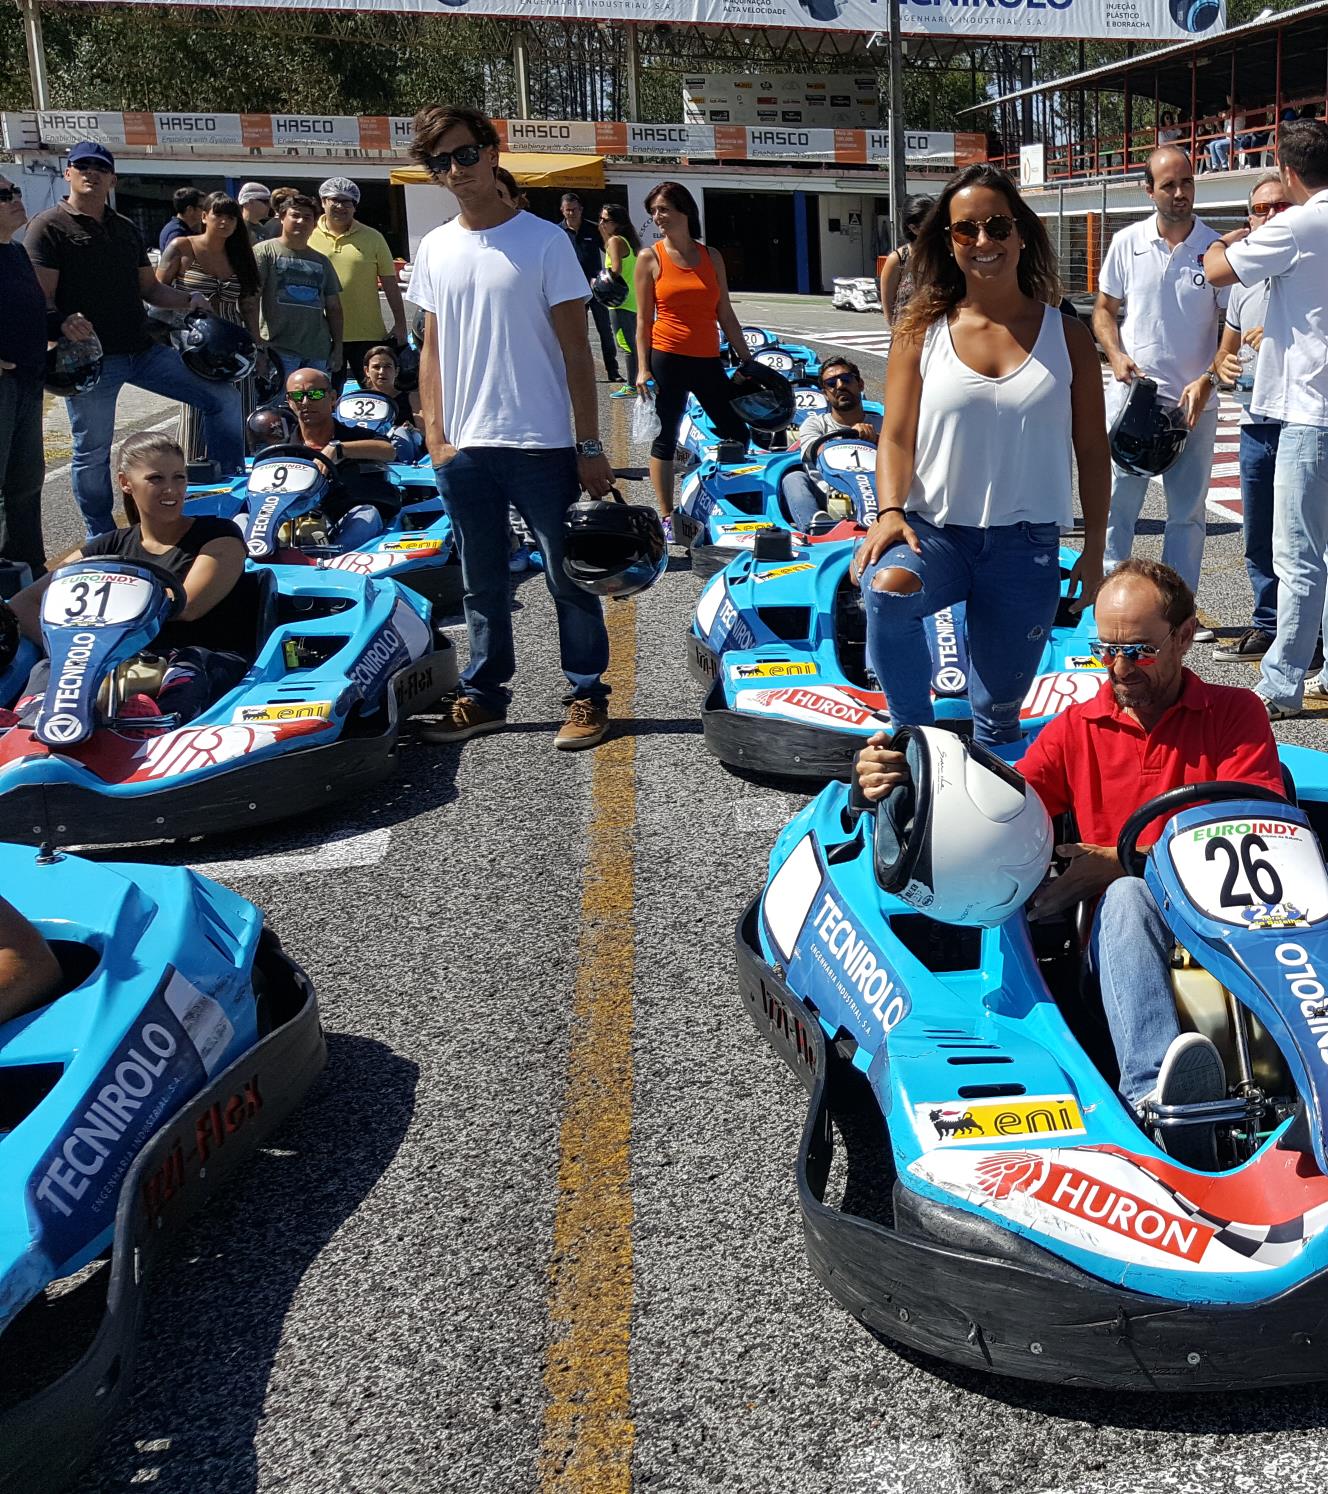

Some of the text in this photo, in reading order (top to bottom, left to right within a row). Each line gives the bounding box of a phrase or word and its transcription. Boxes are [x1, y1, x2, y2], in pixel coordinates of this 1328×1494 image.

[743, 7, 787, 15] VELOCIDADE
[1106, 11, 1140, 19] PLÁSTICO
[1027, 18, 1047, 26] S.A.
[43, 116, 99, 130] HASCO
[159, 117, 217, 132] HASCO
[276, 119, 334, 134] HASCO
[512, 124, 571, 139] HASCO
[751, 131, 809, 146] HASCO
[744, 334, 758, 345] 20
[767, 356, 784, 368] 28
[353, 400, 376, 417] 32
[795, 394, 817, 407] 22
[850, 449, 861, 468] 1
[271, 467, 288, 489] 9
[405, 540, 439, 550] eni
[779, 563, 810, 575] eni
[61, 575, 139, 585] EUROINDY
[64, 581, 112, 618] 31
[53, 632, 96, 713] TECNIROLO
[768, 662, 812, 676] eni
[276, 703, 324, 720] eni
[793, 690, 864, 723] HURON
[1193, 822, 1299, 842] EUROINDY
[1205, 833, 1284, 908] 26
[1249, 904, 1289, 920] 24
[812, 892, 905, 1033] TECNIROLO
[810, 943, 872, 1038] ENGENHARIA INDUSTRIAL, S.A.
[36, 1022, 178, 1218] TECNIROLO
[993, 1099, 1074, 1137] eni
[91, 1151, 136, 1213] ENGENHARIA
[1052, 1172, 1198, 1254] HURON
